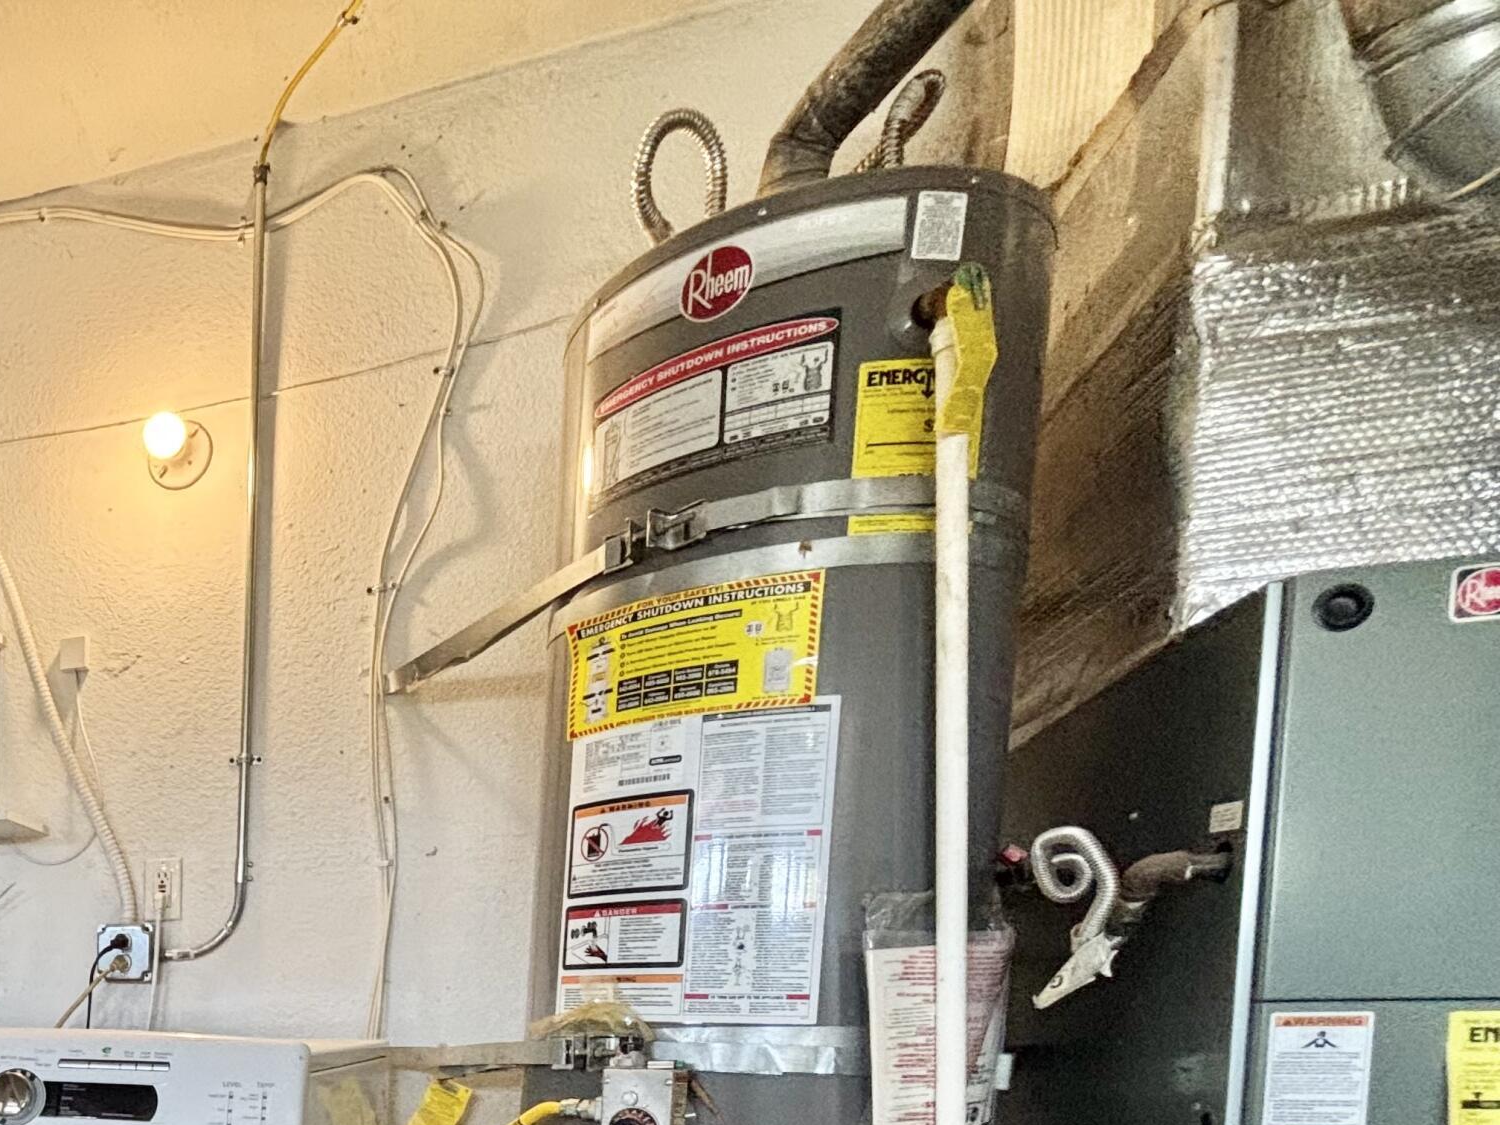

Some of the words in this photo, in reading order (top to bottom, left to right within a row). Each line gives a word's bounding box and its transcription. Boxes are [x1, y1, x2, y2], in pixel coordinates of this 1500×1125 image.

[687, 250, 750, 315] Rheem
[657, 349, 725, 382] SHUTDOWN
[726, 320, 828, 355] INSTRUCTIONS
[579, 614, 634, 638] EMERGENCY
[636, 599, 705, 621] SHUTDOWN
[708, 582, 805, 604] INSTRUCTIONS
